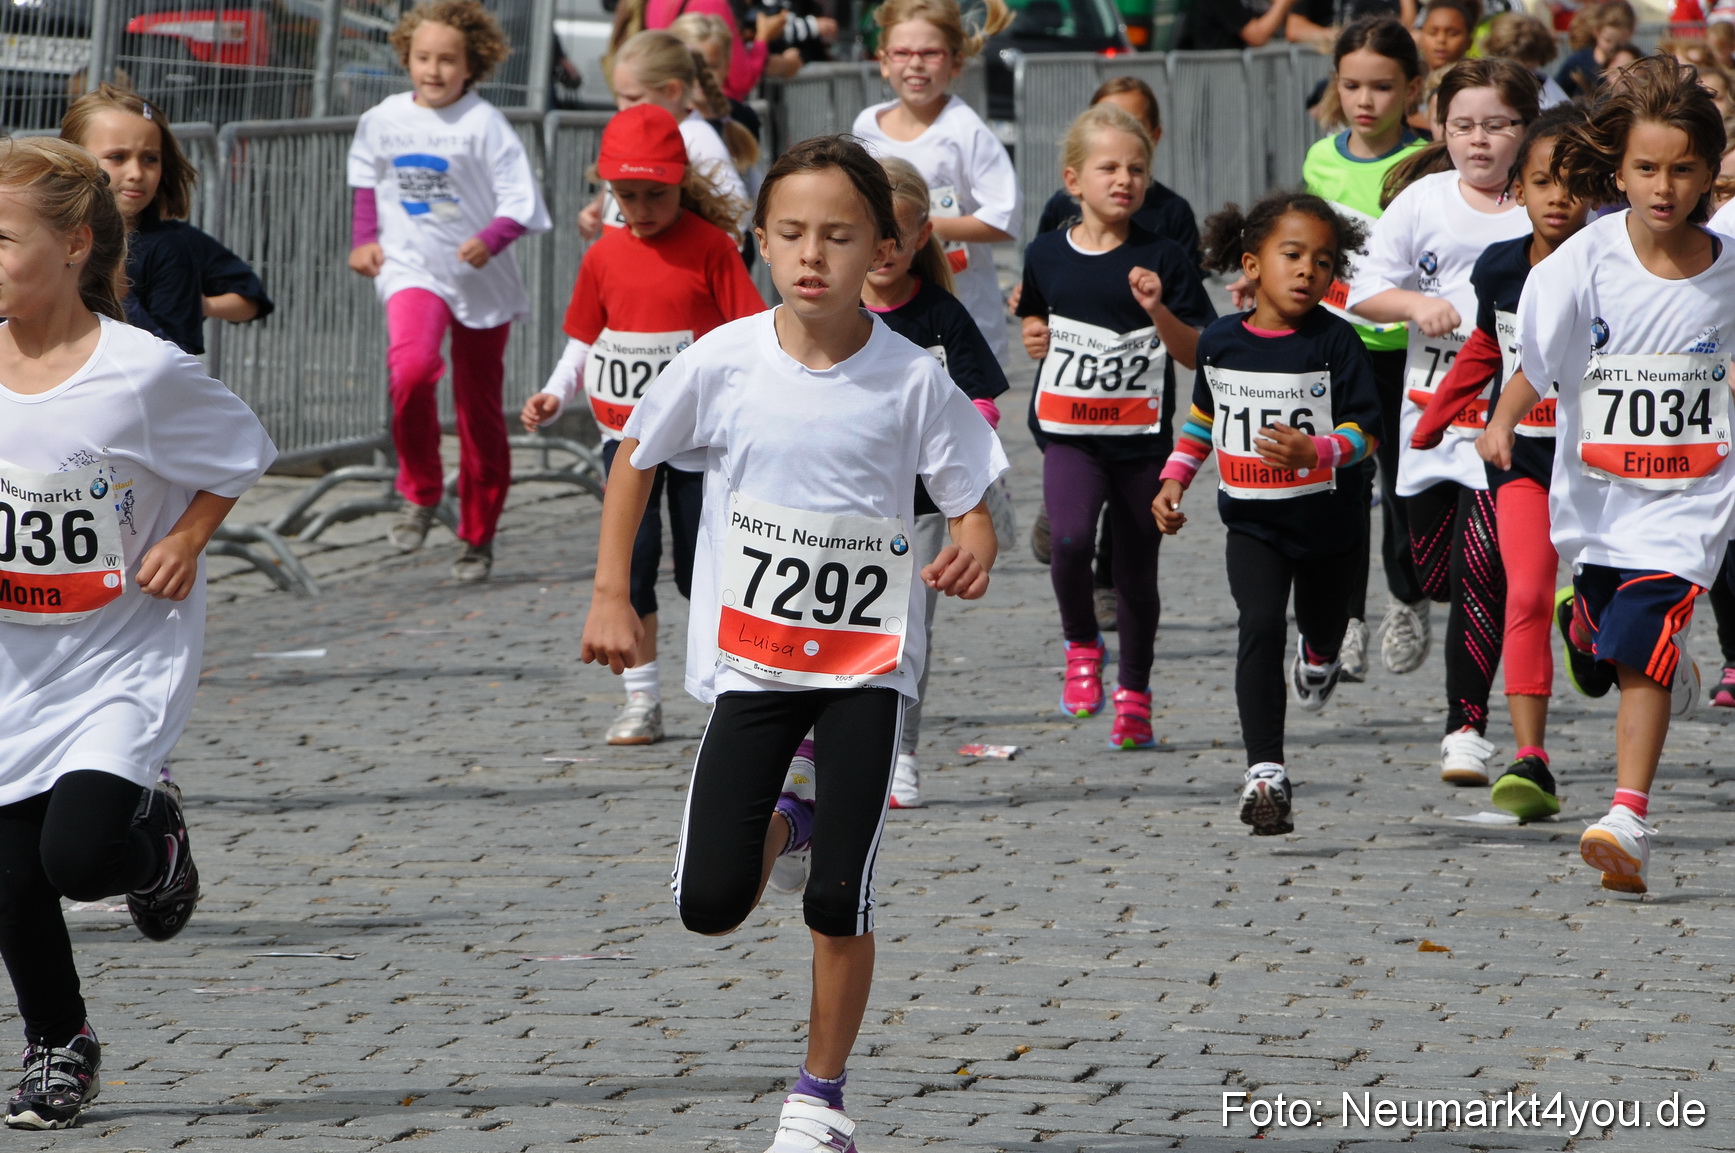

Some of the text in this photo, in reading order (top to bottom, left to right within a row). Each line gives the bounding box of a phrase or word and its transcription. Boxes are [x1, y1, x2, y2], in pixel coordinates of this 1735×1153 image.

[612, 343, 671, 355] Neumarkt
[1054, 346, 1150, 392] 7032
[1638, 368, 1707, 382] Neumarkt
[1210, 379, 1305, 399] PARTL Neumarkt
[1071, 402, 1120, 422] Mona
[1598, 388, 1712, 437] 7034
[1585, 431, 1591, 440] 3
[1717, 430, 1725, 439] W
[1231, 462, 1295, 484] Liliana
[1624, 451, 1690, 477] Erjona
[1, 477, 82, 503] Neumarkt
[732, 511, 787, 542] PARTL
[792, 528, 883, 552] Neumarkt
[106, 556, 116, 567] W
[742, 546, 888, 628] 7292
[738, 623, 794, 657] Luisa
[835, 674, 854, 682] 2005
